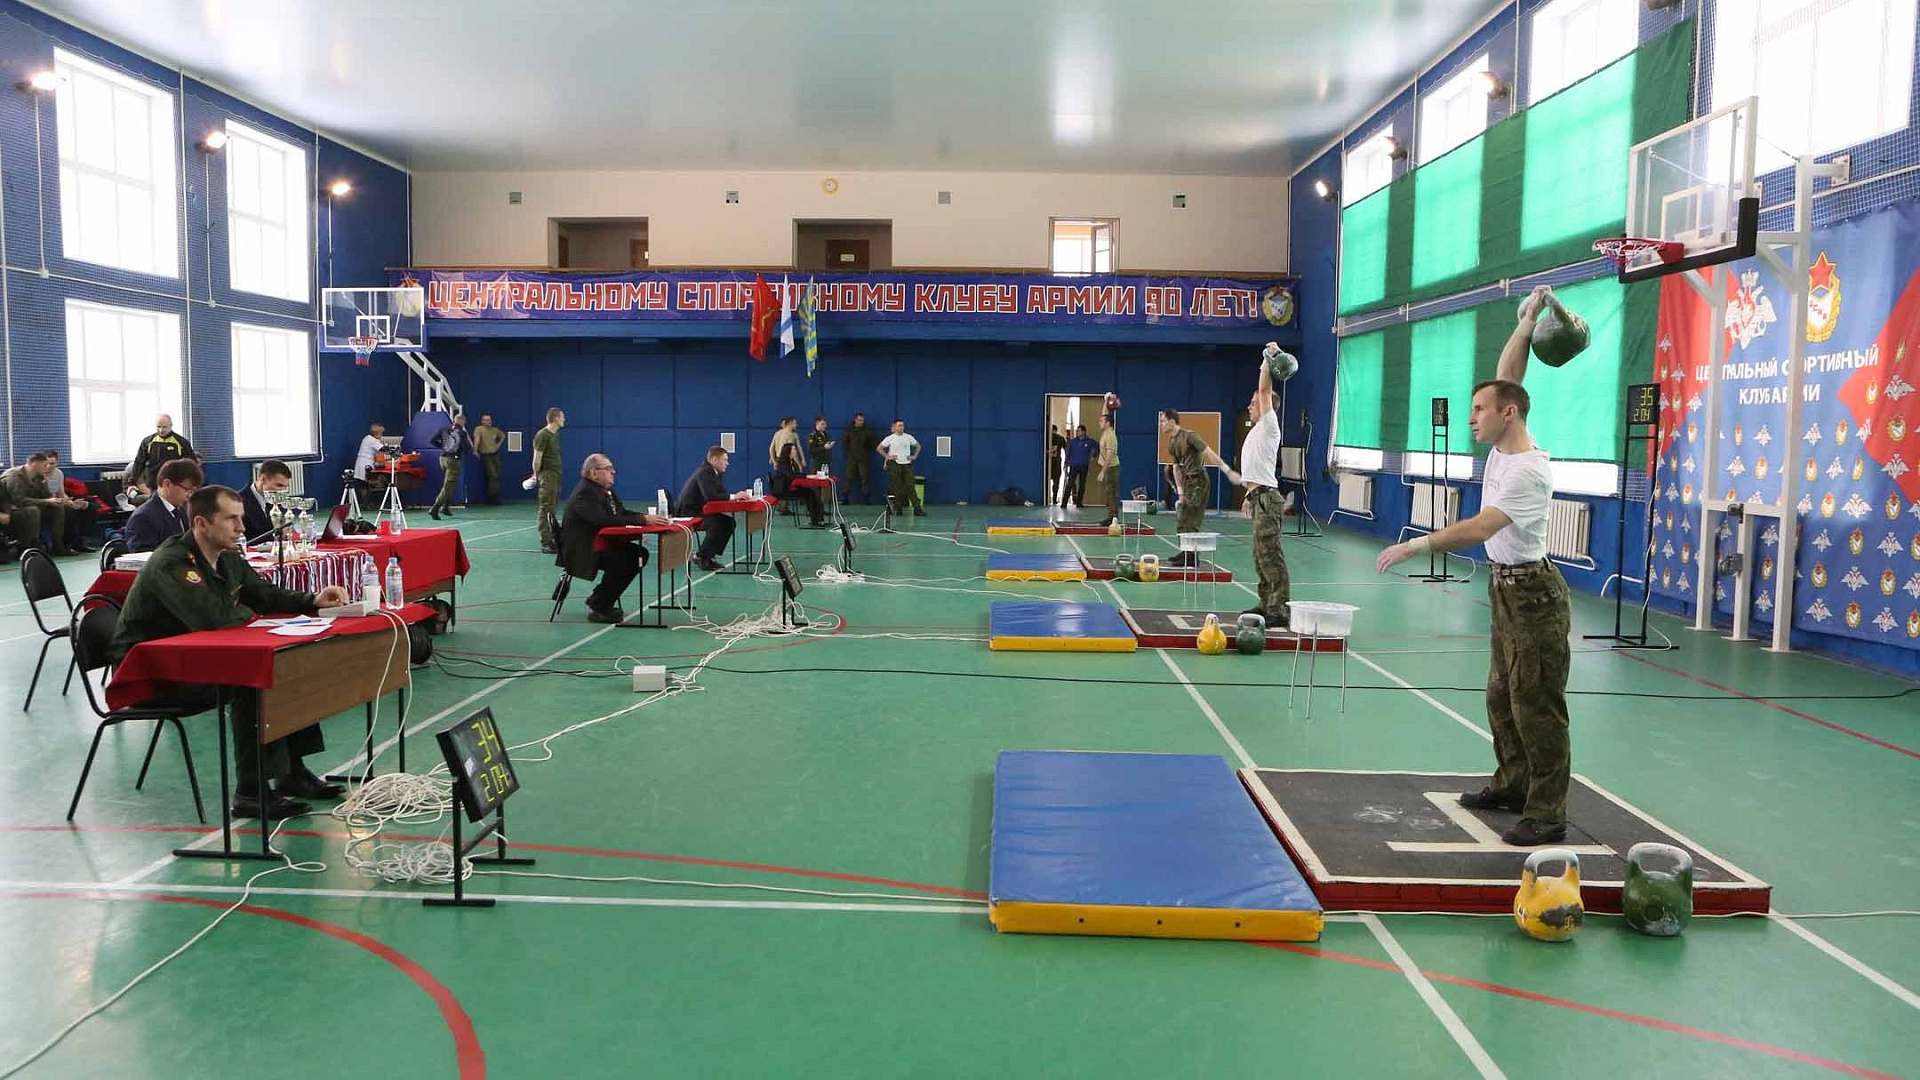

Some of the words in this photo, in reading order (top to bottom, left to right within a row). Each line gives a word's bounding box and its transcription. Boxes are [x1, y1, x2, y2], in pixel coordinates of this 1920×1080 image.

[428, 281, 668, 312] ЦЕНТРАЛЬНОМУ
[677, 282, 905, 312] СПОРИНОМУ
[915, 284, 1018, 313] КЛУБУ
[1026, 285, 1136, 315] АРМИИ
[1145, 287, 1182, 317] 90
[1189, 287, 1258, 318] ЛЕТ!
[1695, 356, 1778, 383] ЦЕТРАЛЬНЫЙ
[1781, 343, 1879, 376] СРТИВНЫЙ
[1739, 387, 1771, 406] КЛУБ
[1772, 384, 1821, 404] АРИ
[471, 716, 501, 763] 34
